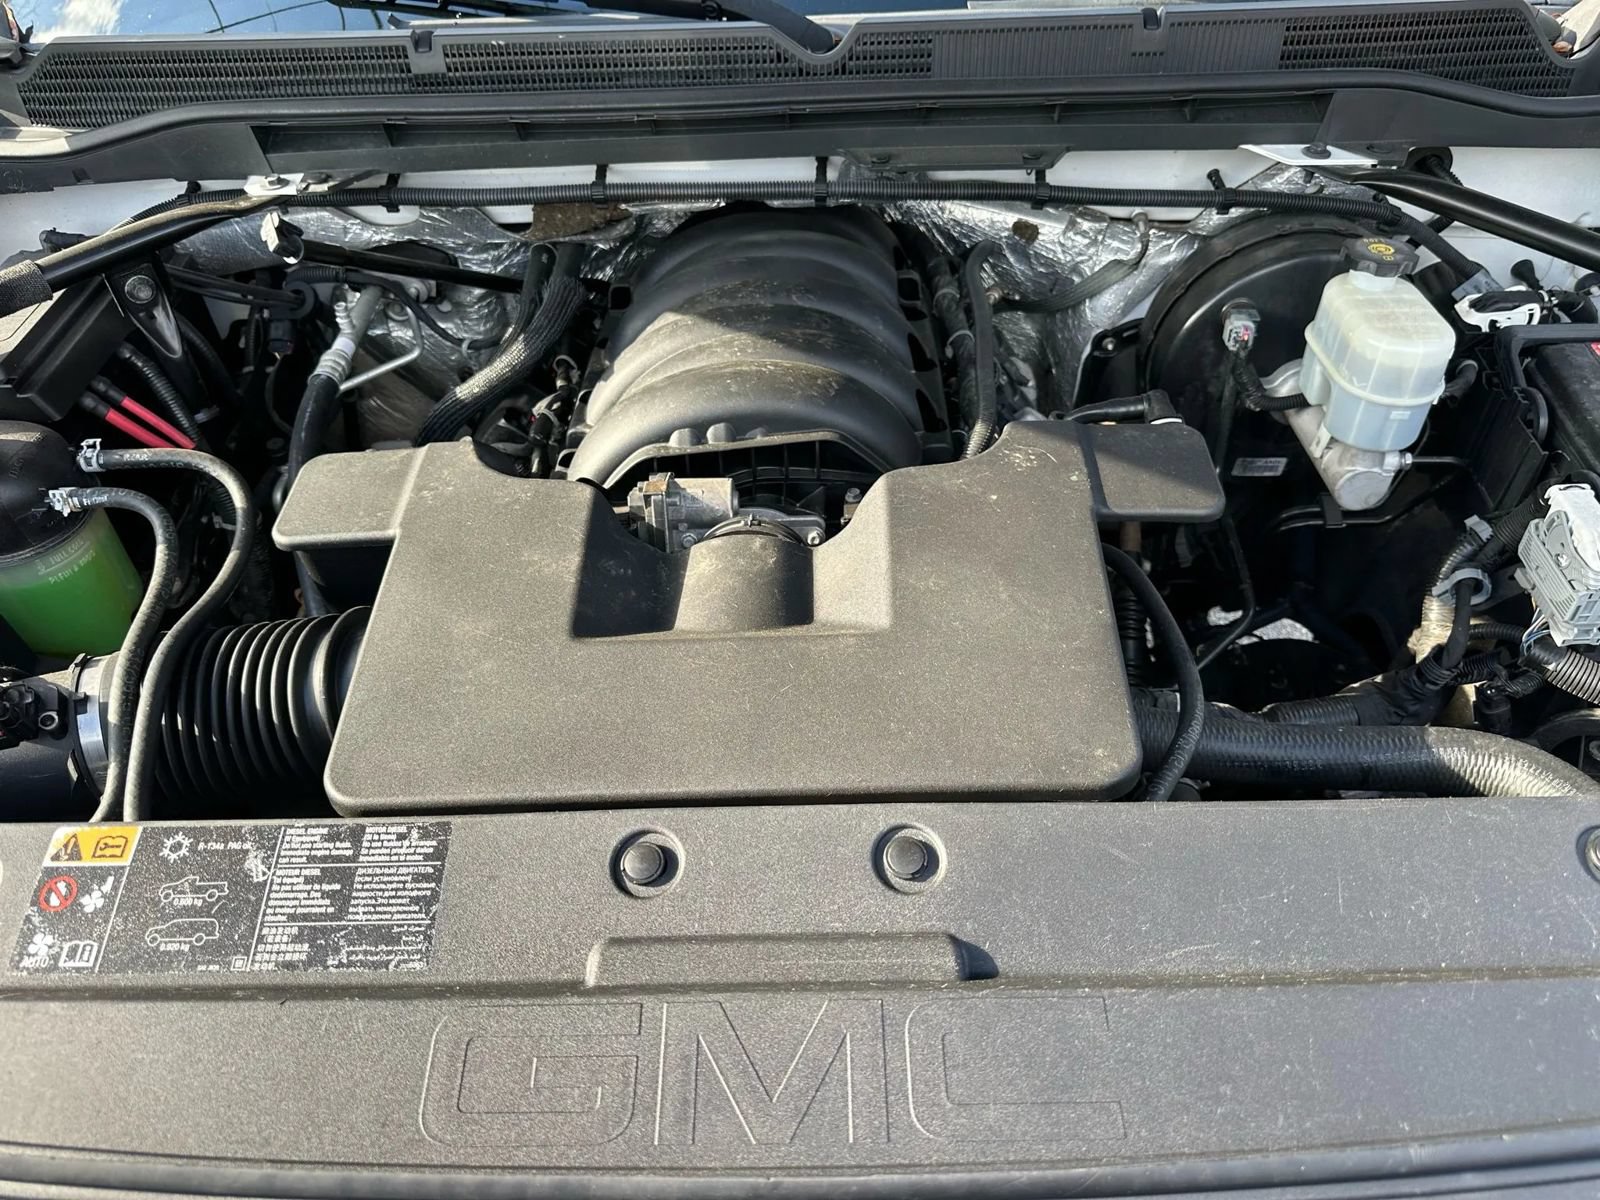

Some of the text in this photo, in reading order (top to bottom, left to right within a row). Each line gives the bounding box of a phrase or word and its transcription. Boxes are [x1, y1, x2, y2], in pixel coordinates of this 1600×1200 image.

[311, 849, 330, 857] engine
[276, 868, 300, 876] MOTEUR
[356, 866, 434, 875] ДИЗЕЛЬНЫЙ ДВИГАТЕЛЬ
[363, 882, 404, 890] используйте
[404, 882, 436, 890] пусковые
[180, 943, 190, 952] kg
[20, 956, 49, 968] AUTO
[419, 995, 1127, 1147] GMC
